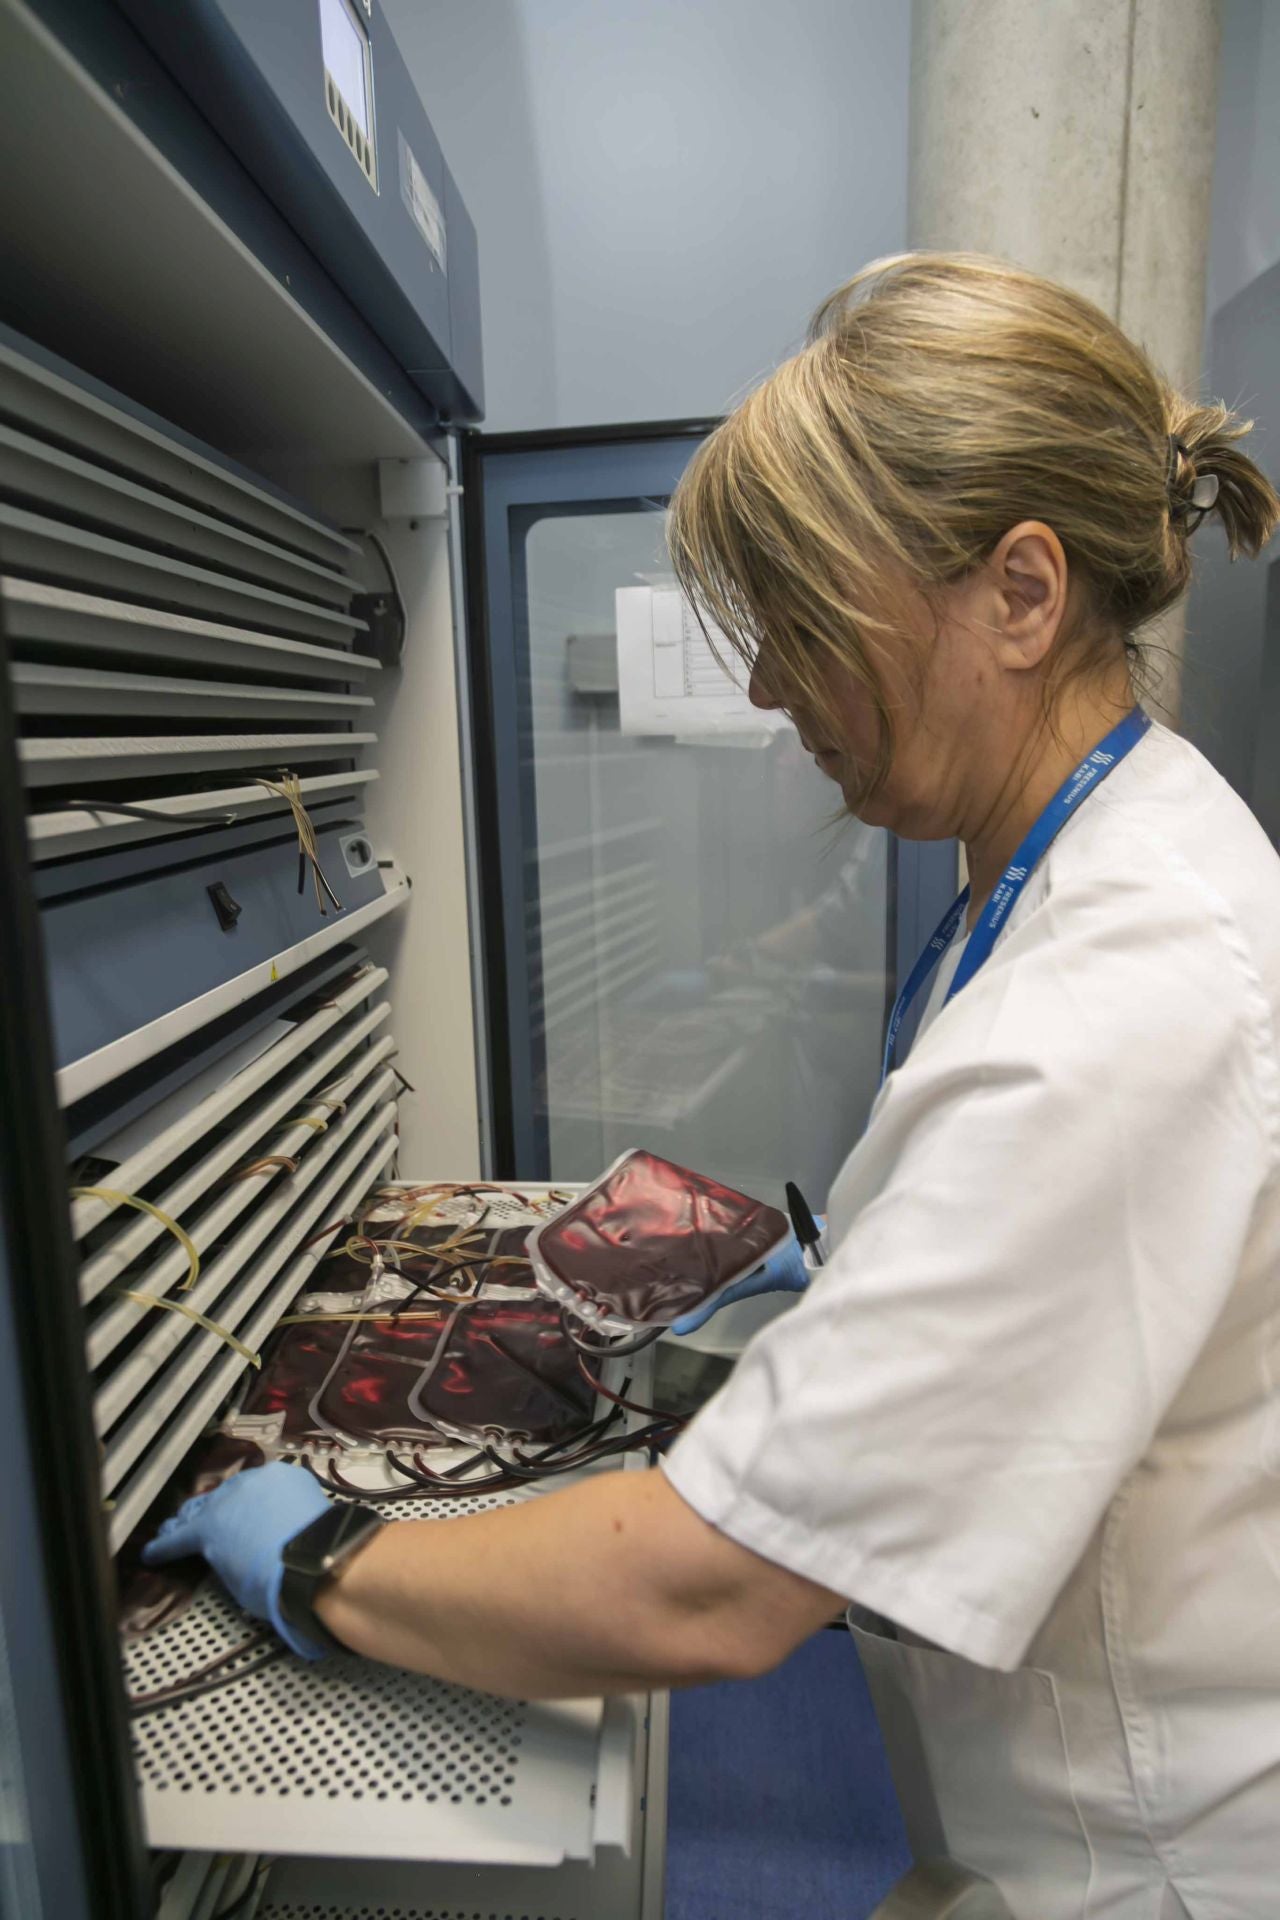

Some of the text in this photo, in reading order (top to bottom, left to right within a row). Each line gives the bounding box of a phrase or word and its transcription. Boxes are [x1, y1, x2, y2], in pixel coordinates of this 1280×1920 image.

[1063, 767, 1098, 805] FRESENIUS
[1072, 763, 1090, 781] KABI
[992, 882, 1006, 903] KABI
[989, 886, 1014, 929] FRESENIUS
